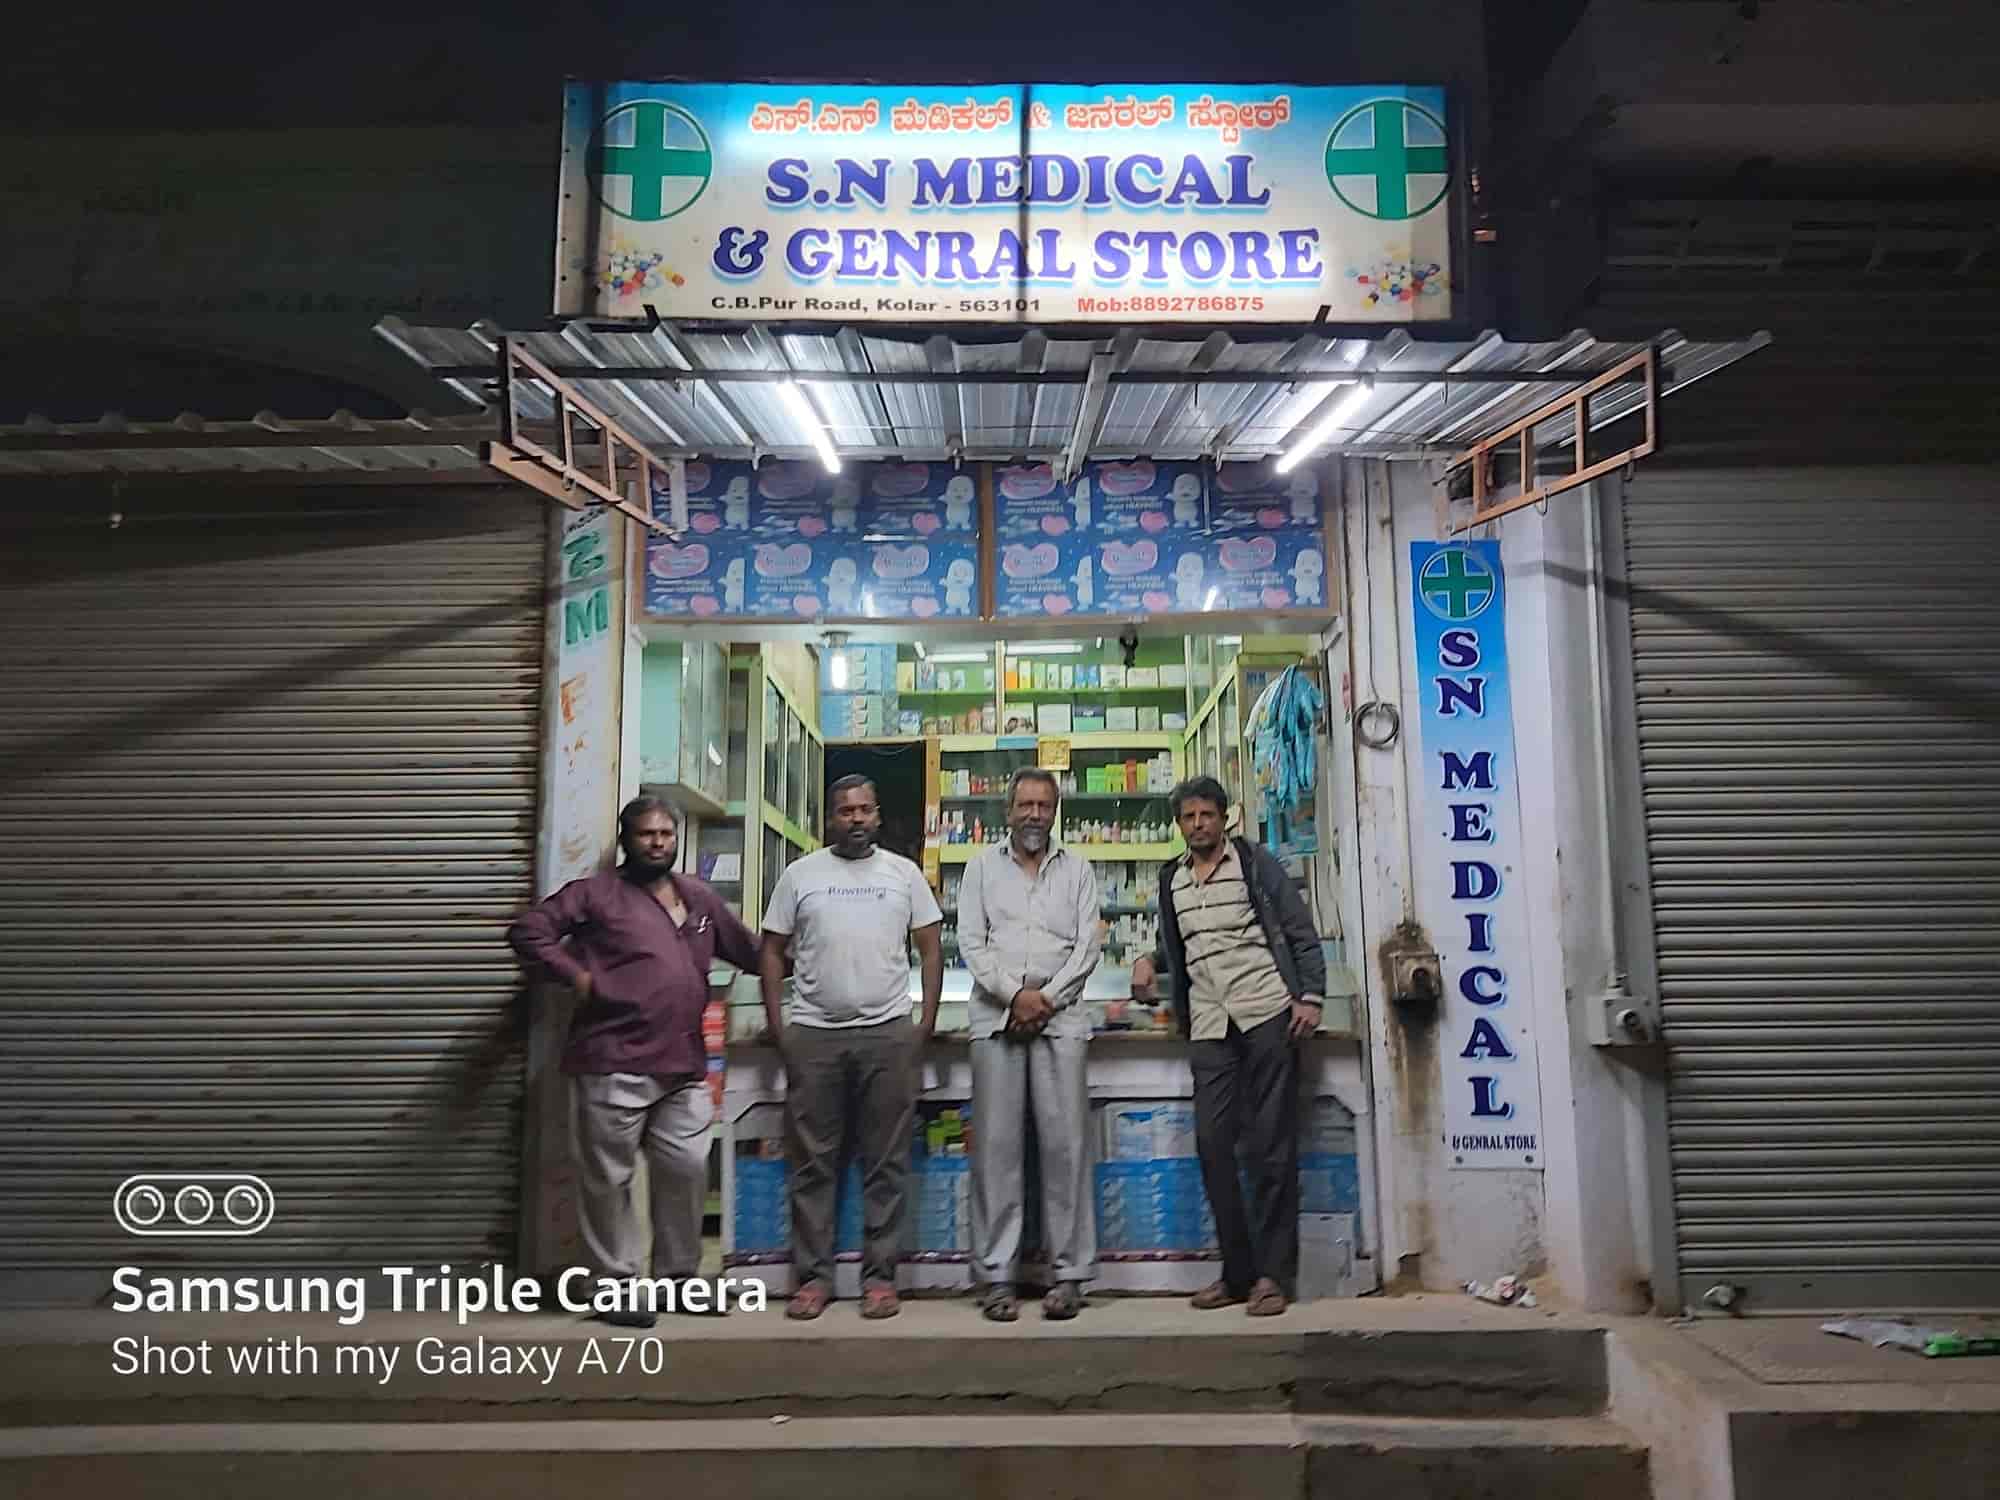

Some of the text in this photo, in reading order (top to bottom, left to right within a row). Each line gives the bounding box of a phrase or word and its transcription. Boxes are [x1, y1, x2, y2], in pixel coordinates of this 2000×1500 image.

[893, 98, 1011, 131] ಮೆಡಿಕಲ್
[1067, 97, 1173, 130] ಜನರಲ್
[1189, 97, 1290, 143] ಸ್ಟೋರ್
[766, 154, 1271, 206] S.N MEDICAL
[713, 227, 1324, 280] & GENRAL STORE
[711, 296, 797, 310] C.B.Pur
[805, 297, 868, 313] Road,
[877, 298, 937, 312] Kolar
[959, 299, 1040, 313] 563101
[1077, 296, 1265, 313] Mob:8892786875
